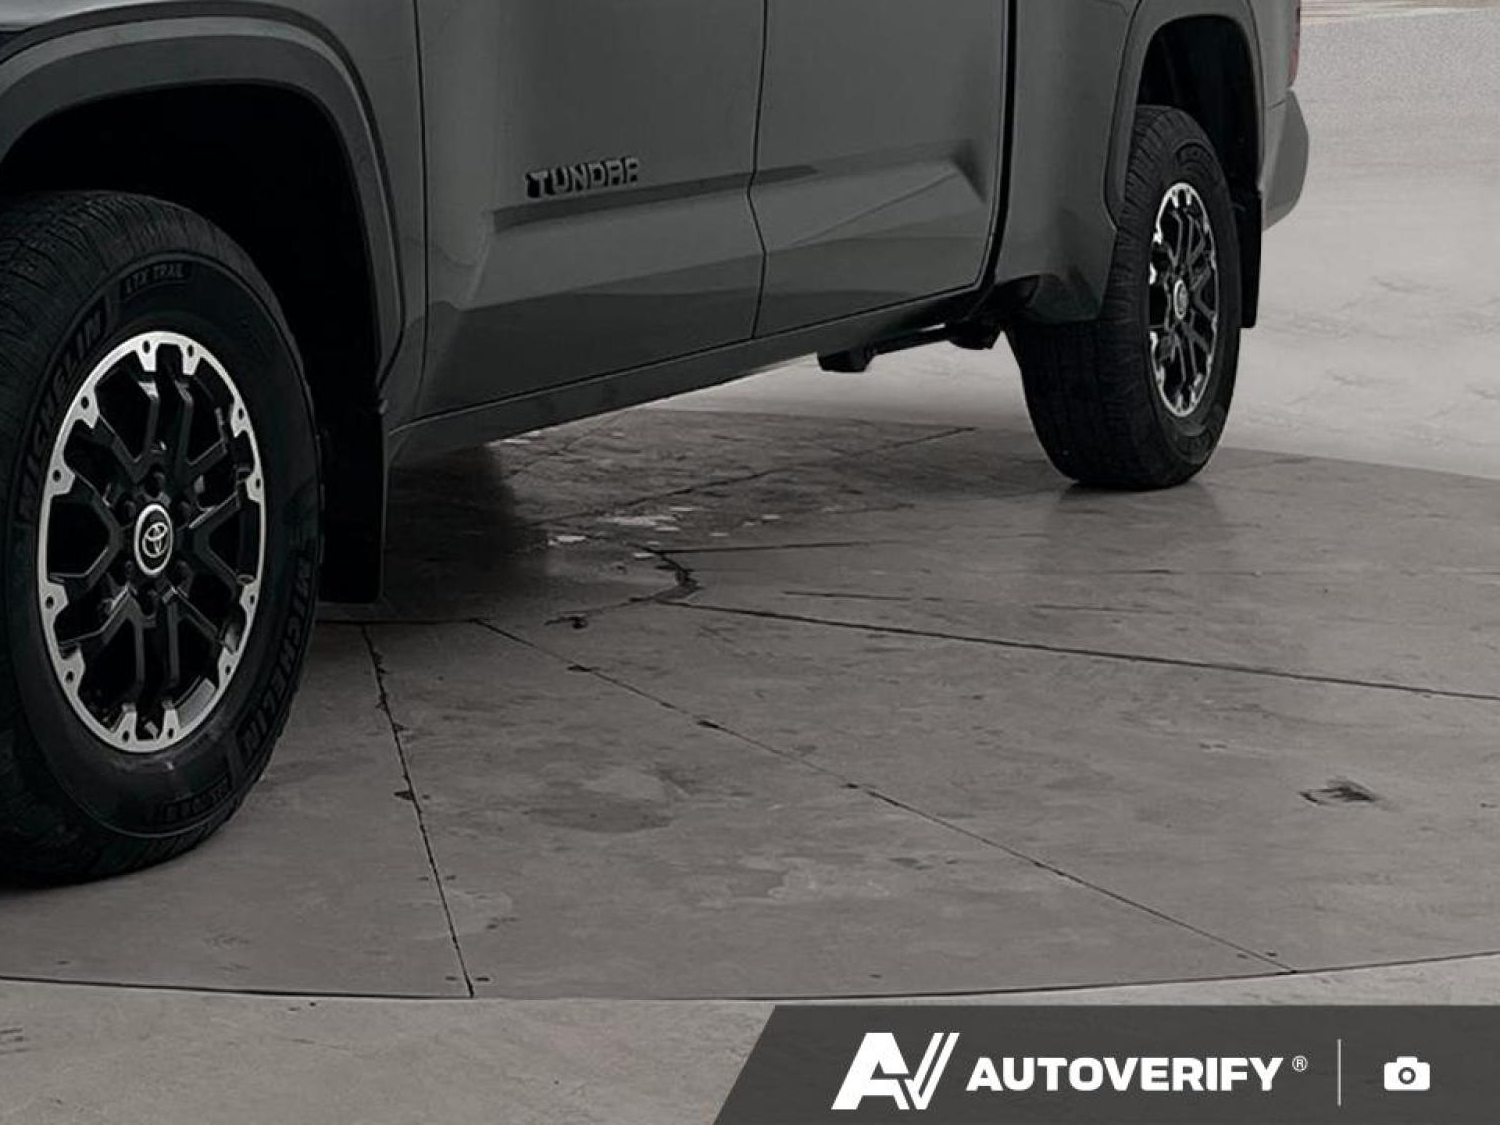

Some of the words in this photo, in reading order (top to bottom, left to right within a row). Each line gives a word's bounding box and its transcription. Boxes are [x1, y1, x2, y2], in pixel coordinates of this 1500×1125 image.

[525, 157, 639, 199] TUNDRA
[18, 294, 105, 523] MICHELIN
[238, 555, 313, 770] MICHELIN
